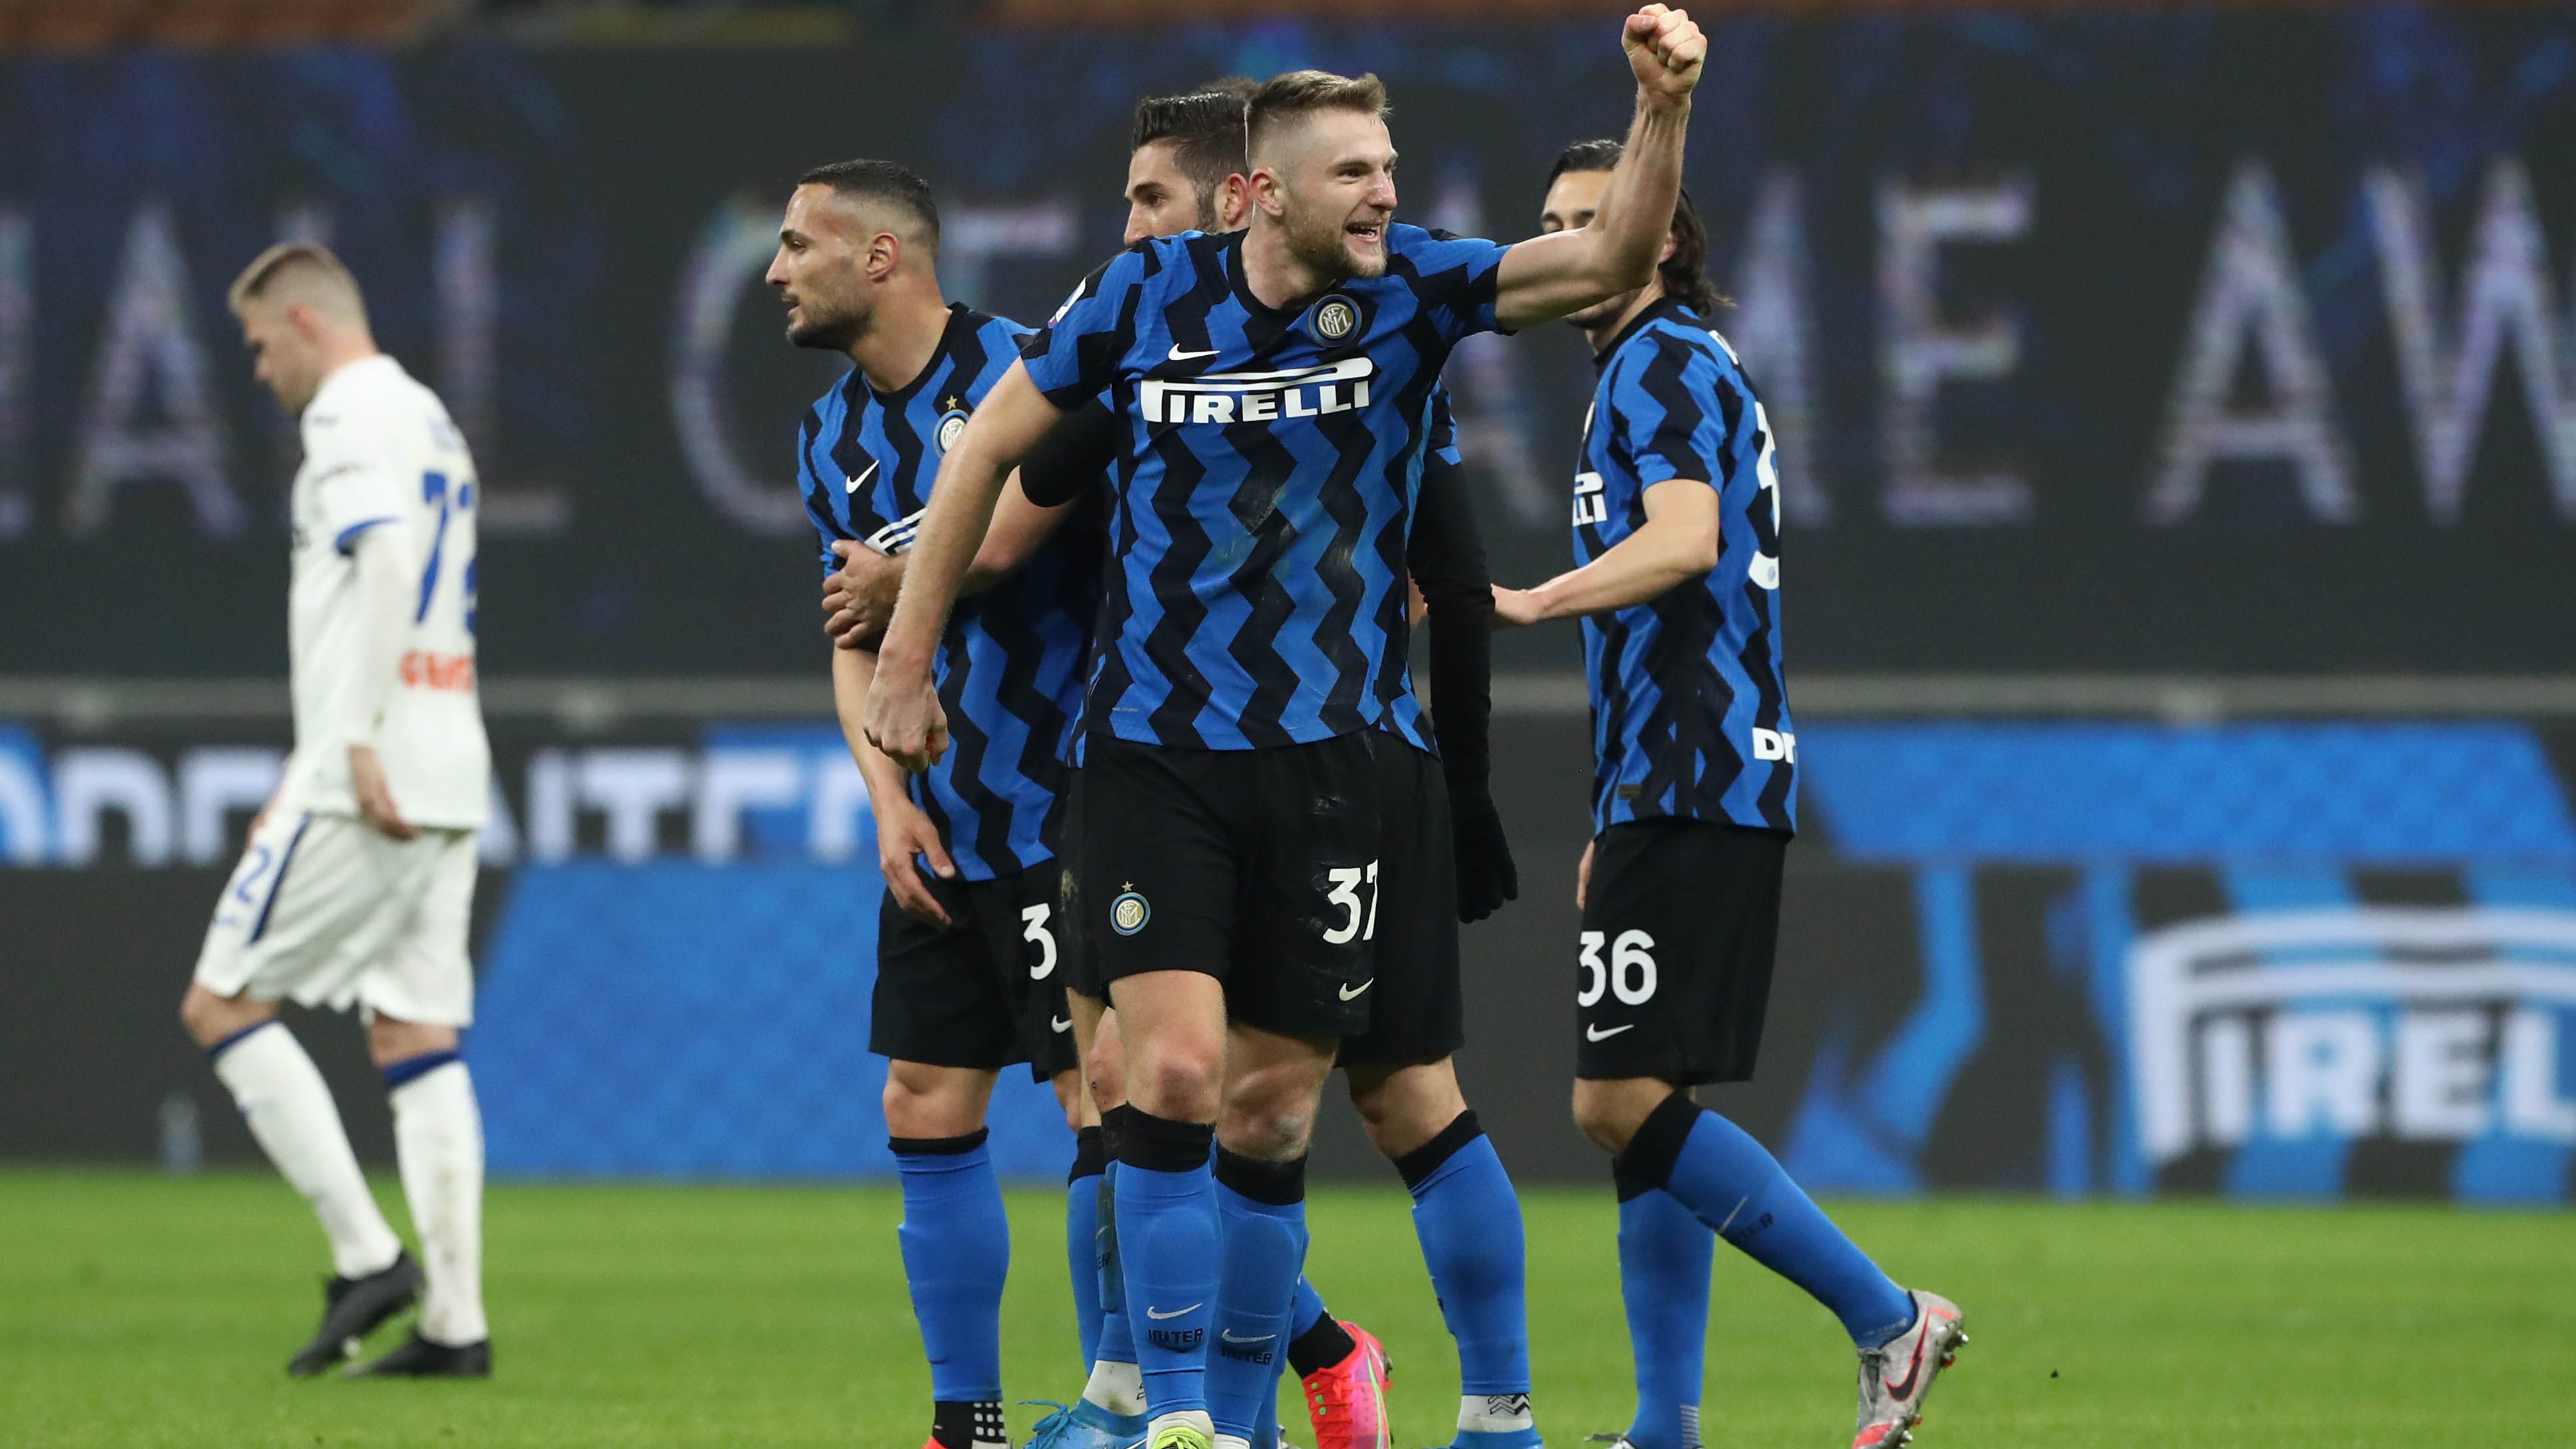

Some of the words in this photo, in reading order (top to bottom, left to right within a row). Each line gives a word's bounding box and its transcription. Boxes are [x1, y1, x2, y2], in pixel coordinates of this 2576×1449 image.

[1140, 357, 1373, 424] PIRELLI
[1322, 859, 1378, 944] 37
[1578, 929, 1657, 1007] 36
